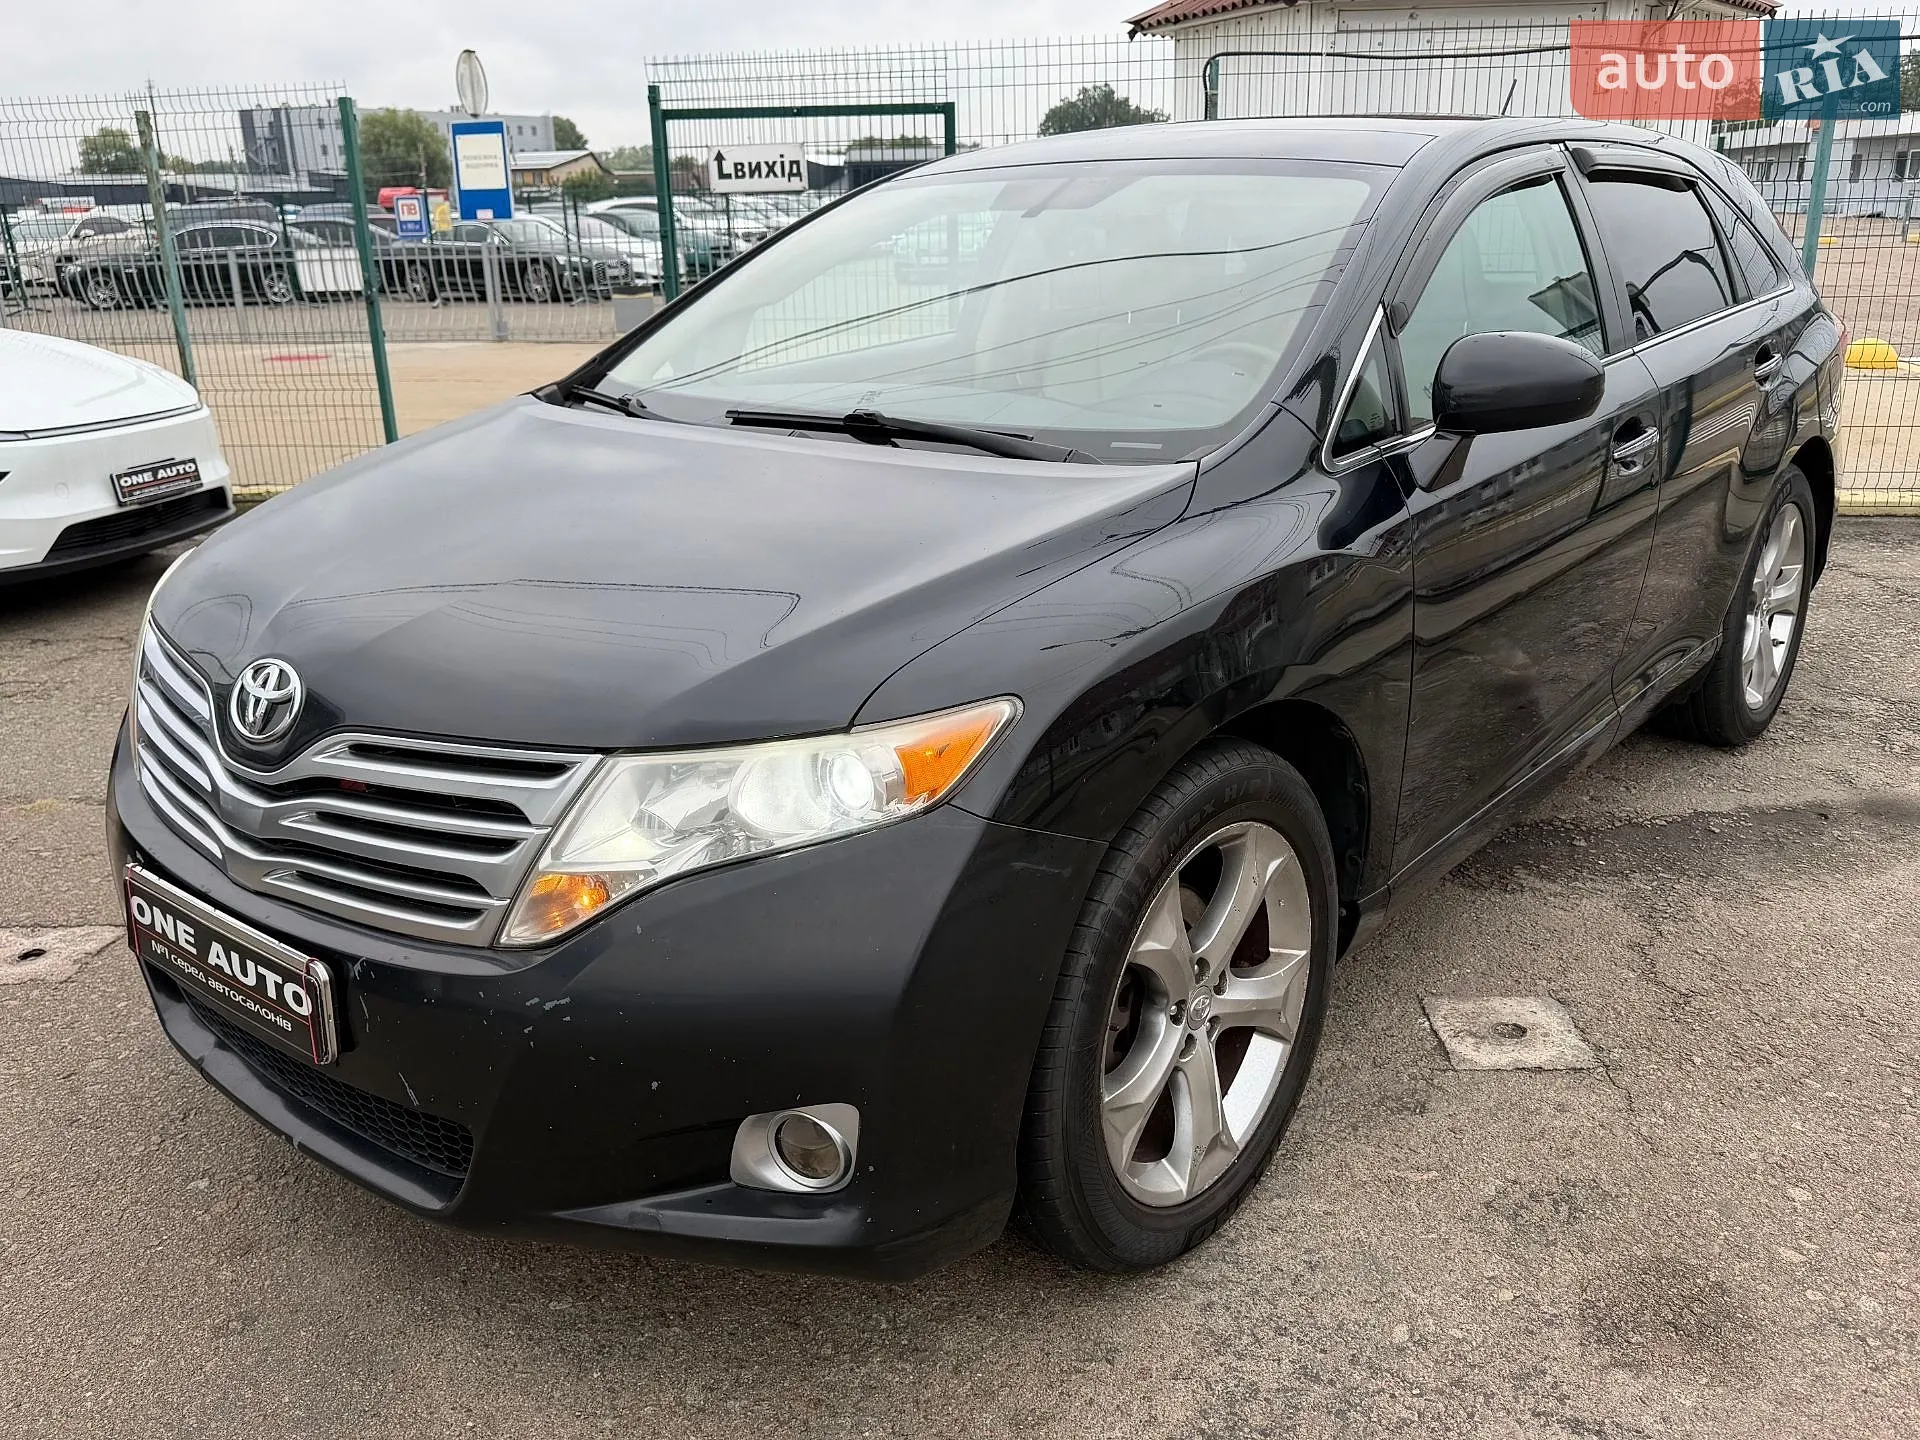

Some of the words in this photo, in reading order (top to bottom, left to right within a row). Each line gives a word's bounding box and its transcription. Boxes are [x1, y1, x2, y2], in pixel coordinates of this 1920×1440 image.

[120, 471, 154, 487] ONE
[157, 462, 196, 480] AUTO
[130, 895, 198, 956] ONE
[207, 941, 313, 1017] AUTO
[171, 953, 207, 986] серед
[207, 973, 292, 1032] автосалонів
